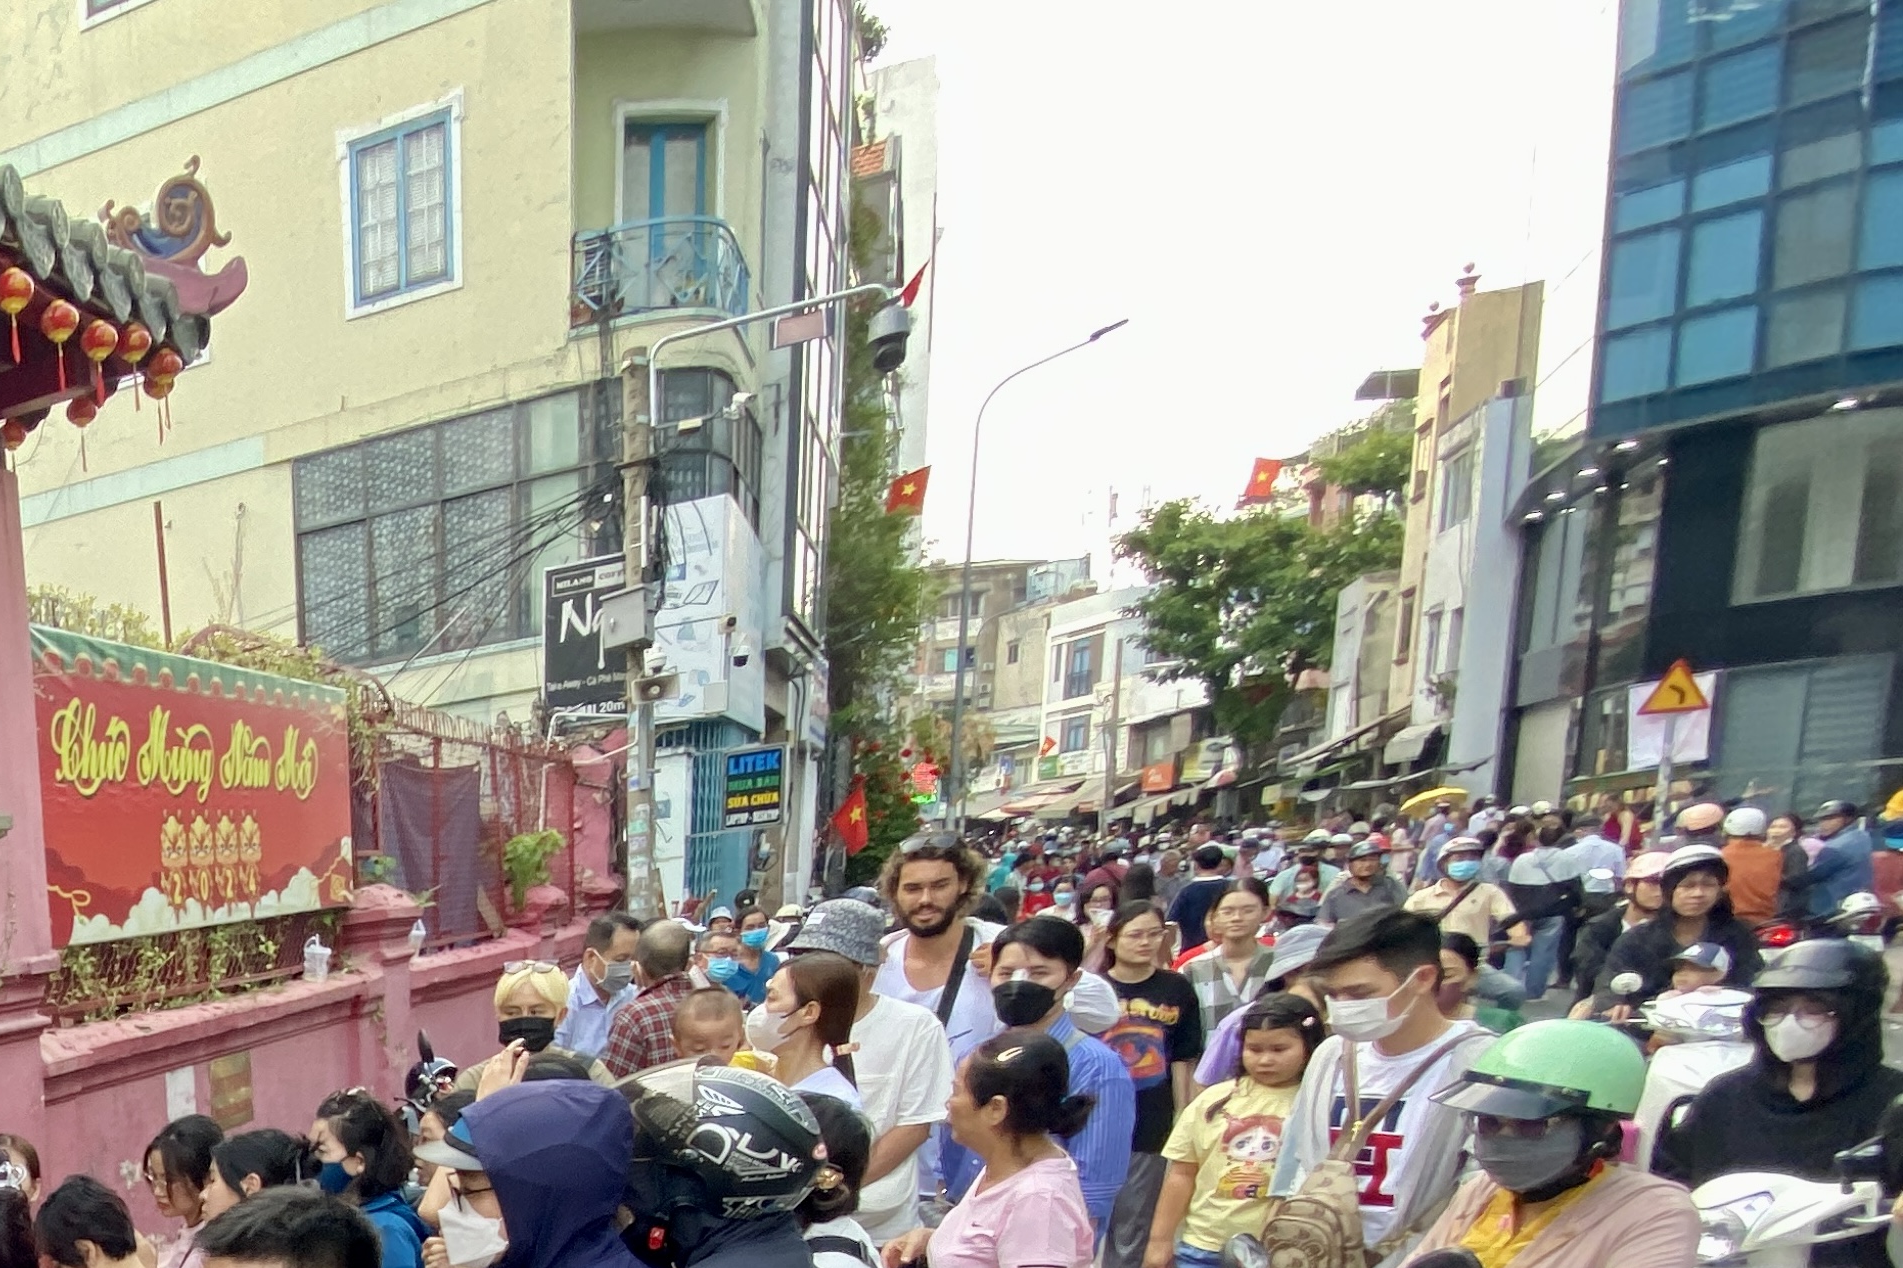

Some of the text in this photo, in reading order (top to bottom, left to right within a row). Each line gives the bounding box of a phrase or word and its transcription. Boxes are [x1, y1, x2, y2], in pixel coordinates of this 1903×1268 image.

[50, 696, 132, 797] Chúc
[135, 704, 215, 804] Mừng
[219, 718, 273, 790] Năm
